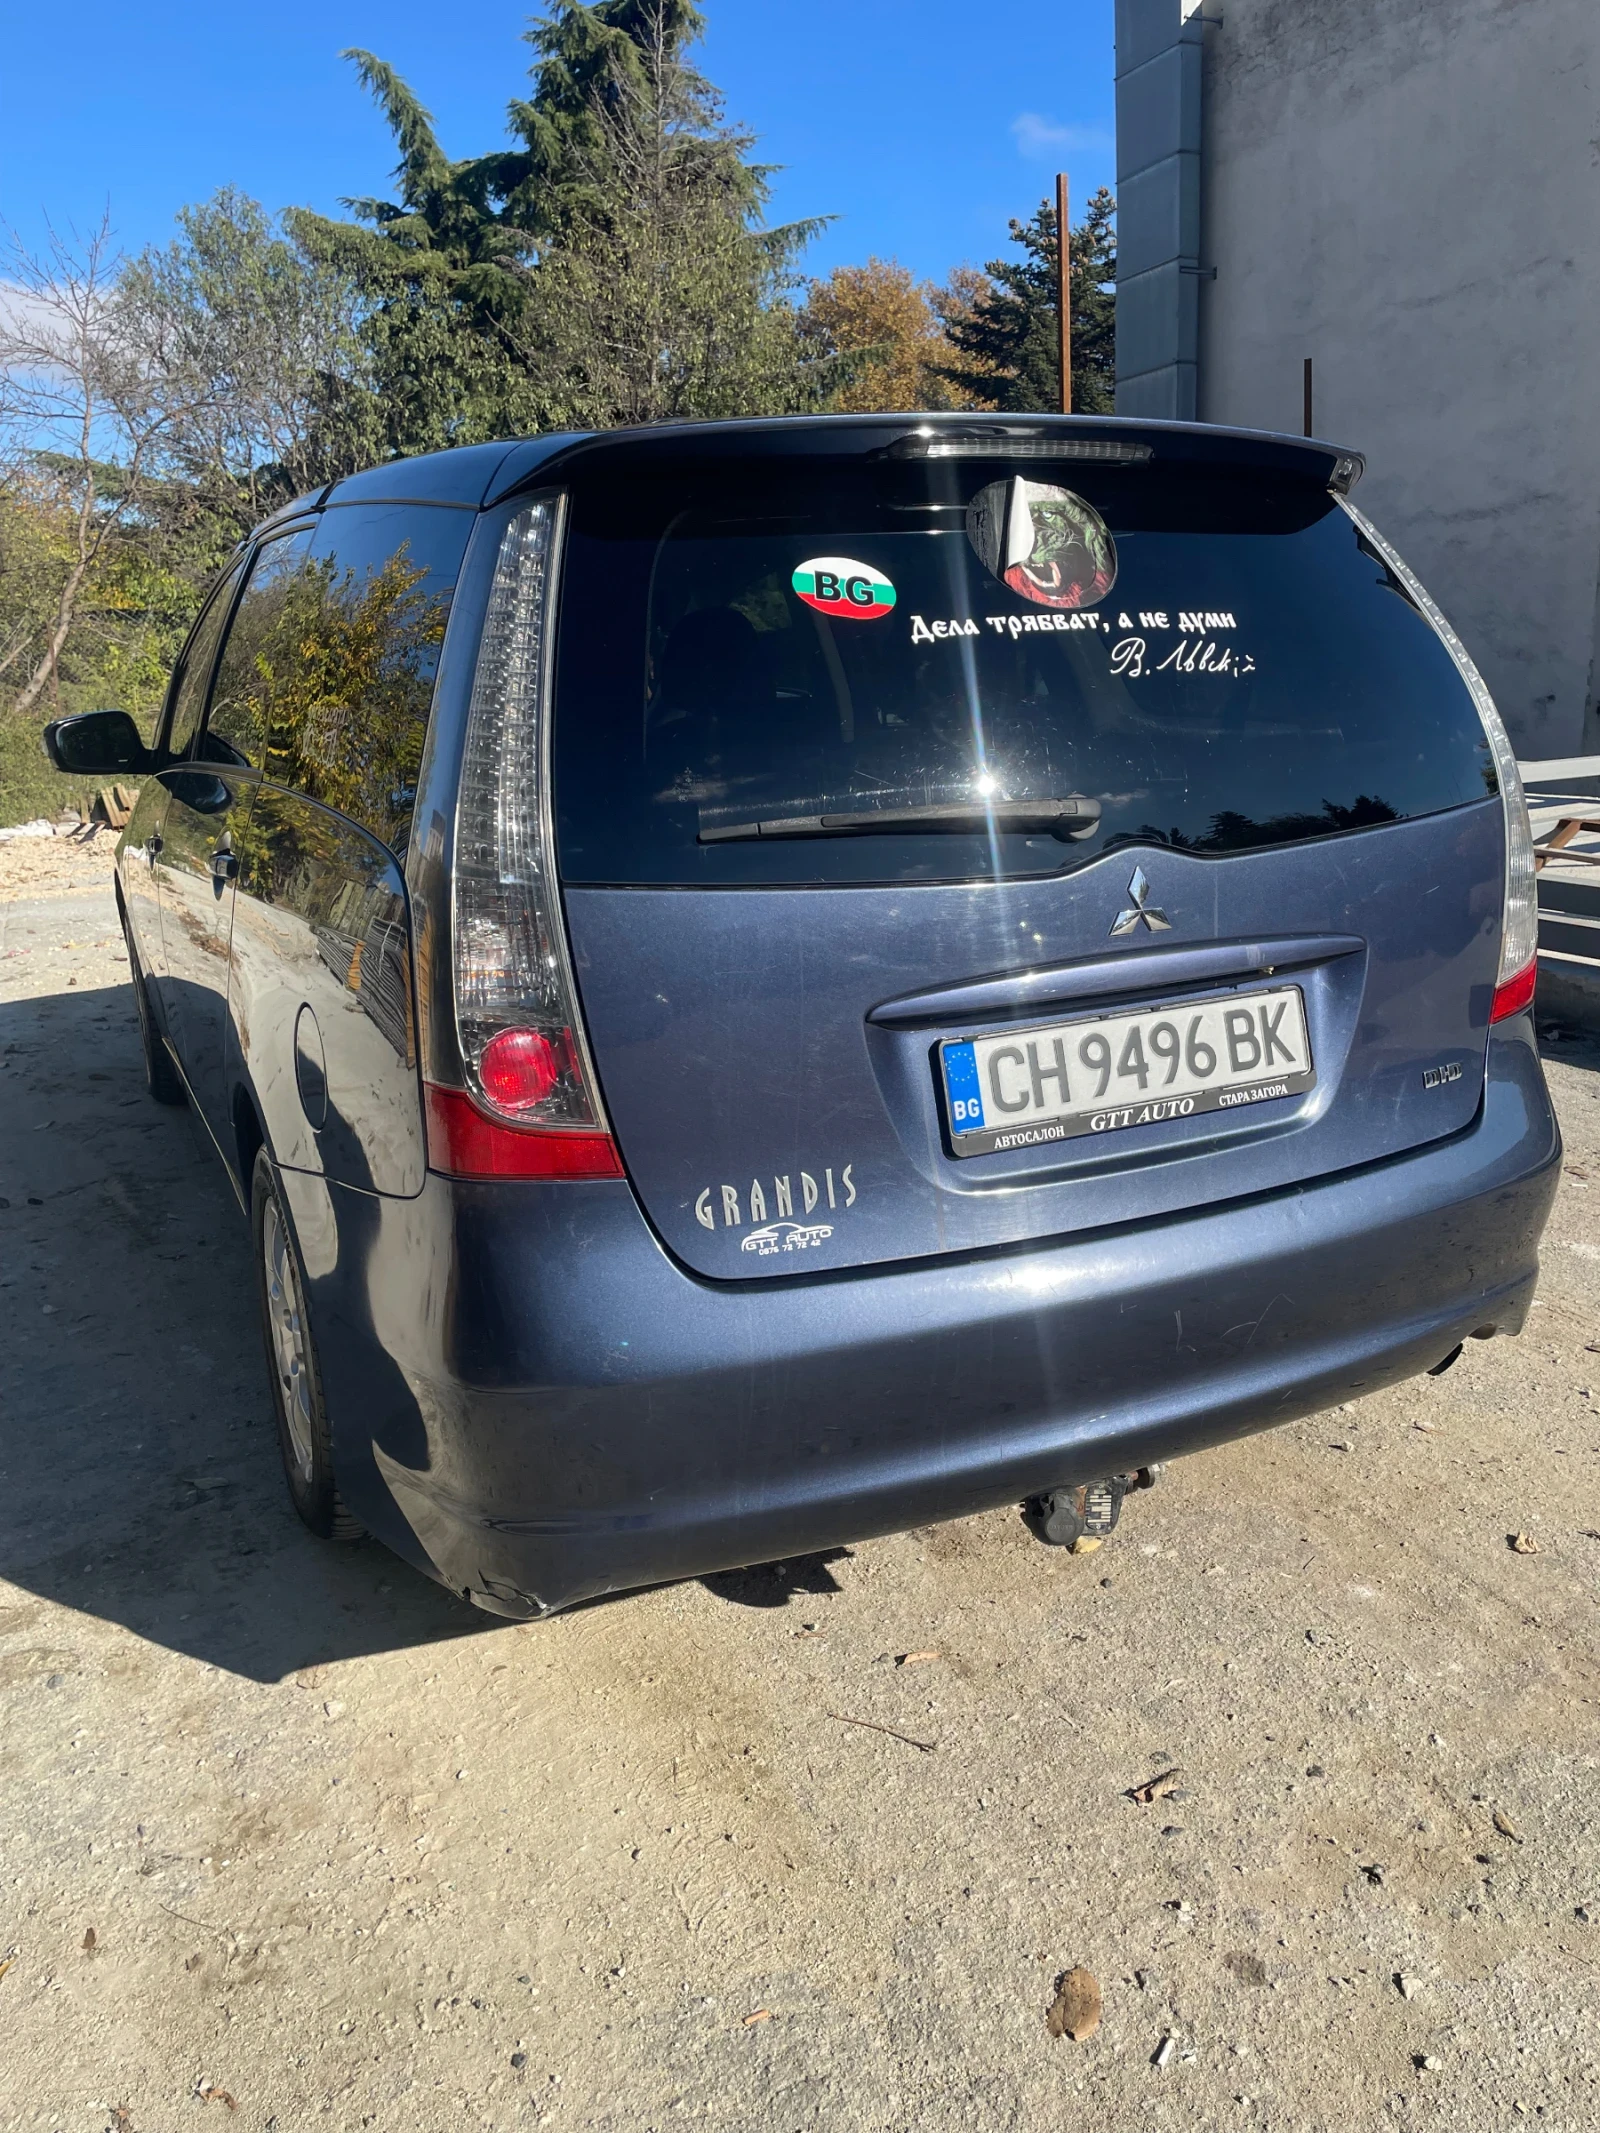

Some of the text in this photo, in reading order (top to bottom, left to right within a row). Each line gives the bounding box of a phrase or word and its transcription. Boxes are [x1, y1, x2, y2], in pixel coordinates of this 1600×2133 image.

[813, 570, 876, 606] BG
[911, 616, 980, 644] Дела
[1118, 612, 1134, 628] а
[1138, 611, 1170, 628] не
[1178, 611, 1237, 635] думи
[1218, 1083, 1289, 1107] СТАРА ЗАГОРА
[954, 1099, 981, 1122] BG
[1090, 1098, 1196, 1132] GTT AUTO
[993, 1125, 1066, 1150] АВТОСАЛОН
[695, 1164, 857, 1231] GRANDIS
[745, 1228, 833, 1251] GTT AUTO
[796, 1241, 808, 1250] 72
